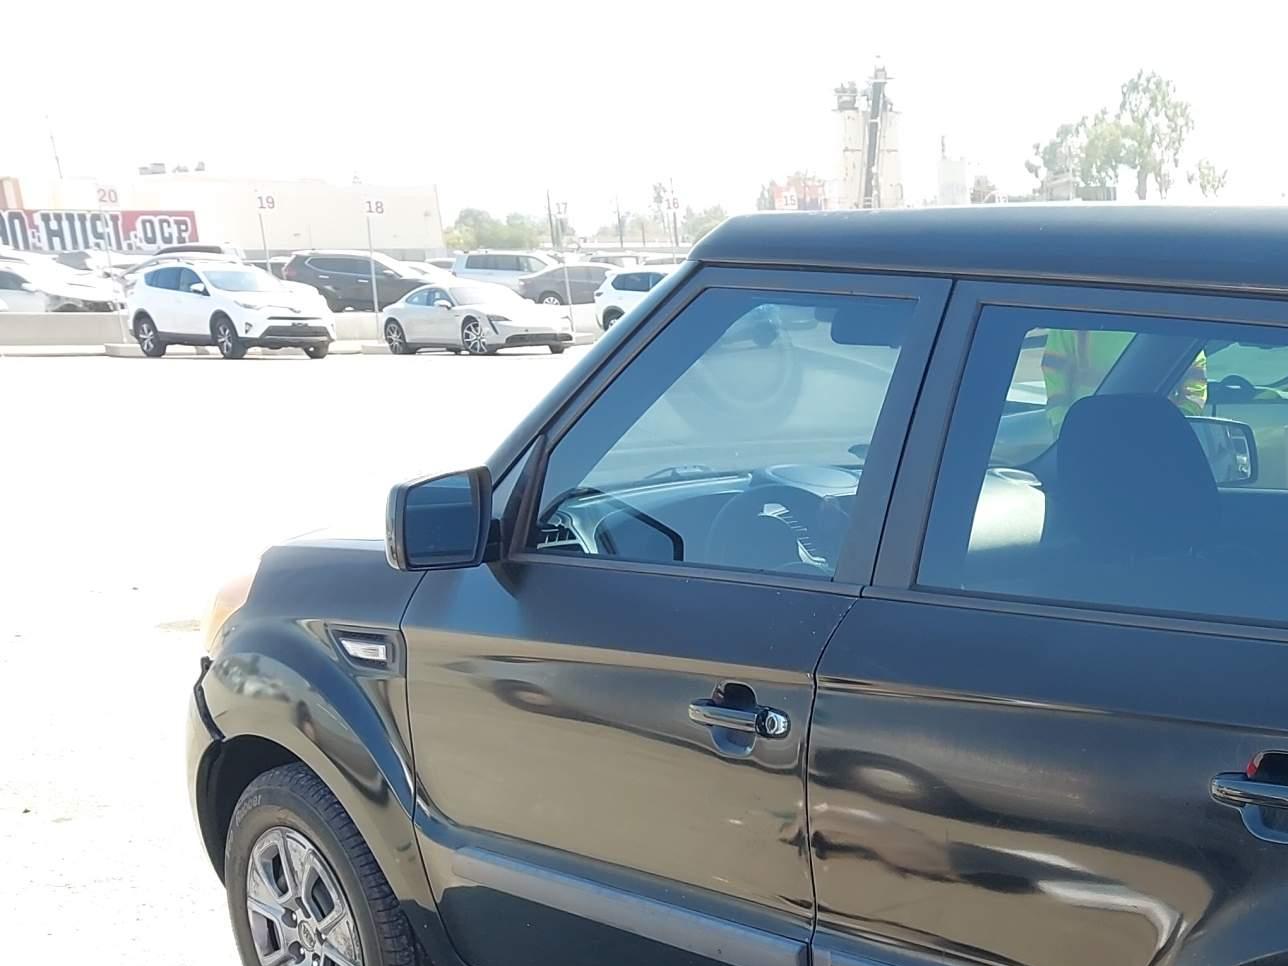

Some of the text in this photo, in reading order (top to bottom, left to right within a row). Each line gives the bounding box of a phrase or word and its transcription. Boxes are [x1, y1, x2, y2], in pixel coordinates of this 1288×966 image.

[97, 188, 119, 203] 20
[257, 195, 276, 210] 19
[365, 200, 385, 215] 18
